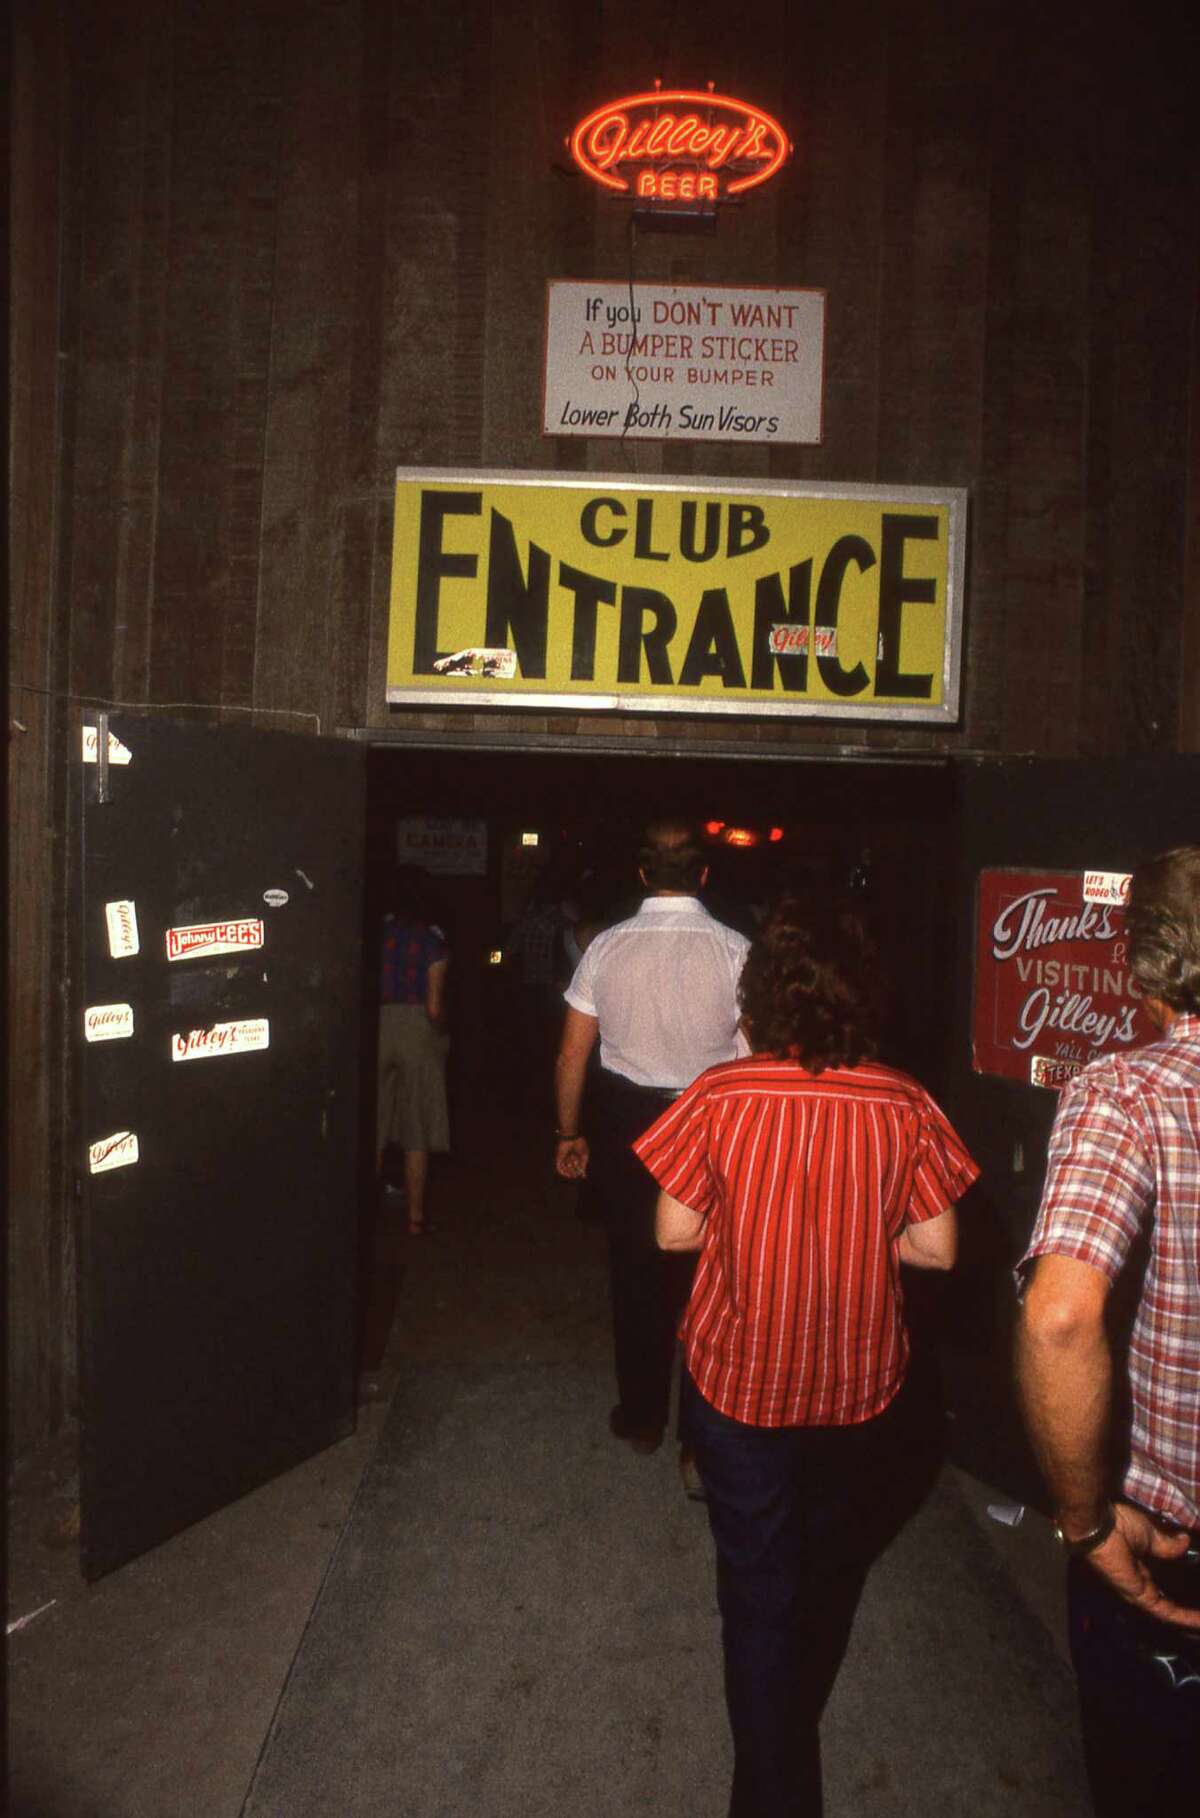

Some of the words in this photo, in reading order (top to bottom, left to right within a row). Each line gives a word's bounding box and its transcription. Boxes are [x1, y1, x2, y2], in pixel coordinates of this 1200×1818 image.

[589, 112, 775, 169] Gilley's
[638, 171, 718, 200] BEER
[585, 297, 604, 322] If
[606, 304, 641, 330] you
[653, 296, 723, 327] DON'T
[731, 304, 799, 329] WANT
[579, 331, 595, 355] A
[601, 332, 693, 360] BUMPER
[701, 336, 799, 363] STICKER
[591, 365, 617, 381] ON
[625, 366, 674, 383] YOUR
[687, 367, 774, 387] BUMPER
[560, 401, 619, 427] Lower
[624, 403, 672, 430] Both
[678, 405, 714, 431] Sun
[717, 405, 779, 434] Visors
[580, 497, 771, 562] CLUB
[412, 489, 940, 699] ENTRANCE
[993, 888, 1118, 960] Thanks
[1012, 986, 1138, 1049] Gilley's
